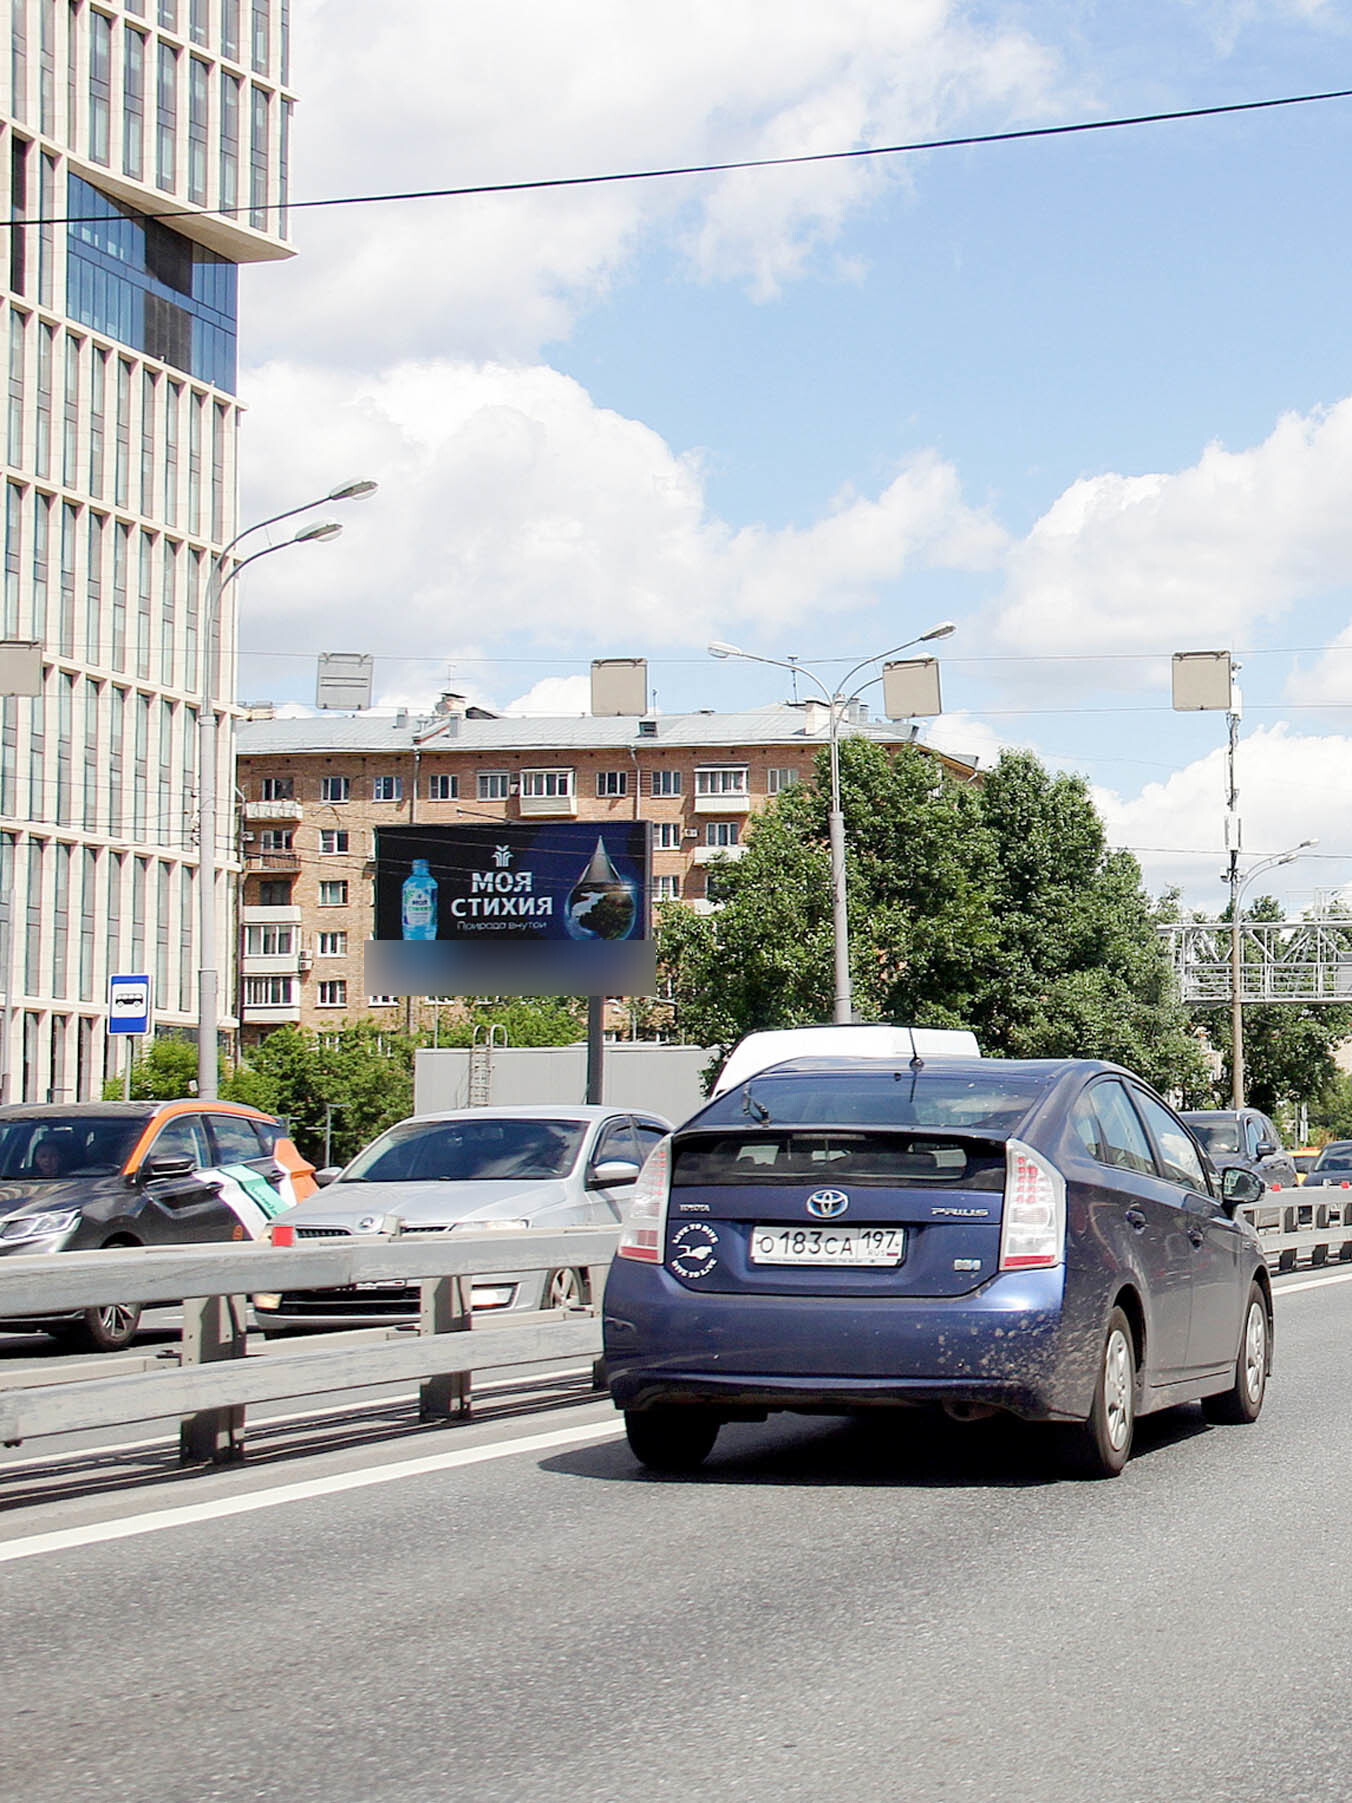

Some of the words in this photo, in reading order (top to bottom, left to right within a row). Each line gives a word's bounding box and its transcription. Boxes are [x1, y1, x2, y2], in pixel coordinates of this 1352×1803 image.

[471, 871, 533, 893] МОЯ
[450, 896, 553, 917] СТИХИЯ
[931, 1207, 989, 1217] PRIUS
[672, 1226, 689, 1244] LIVE
[689, 1223, 702, 1231] TO
[862, 1231, 897, 1249] 197
[867, 1249, 885, 1257] RUS
